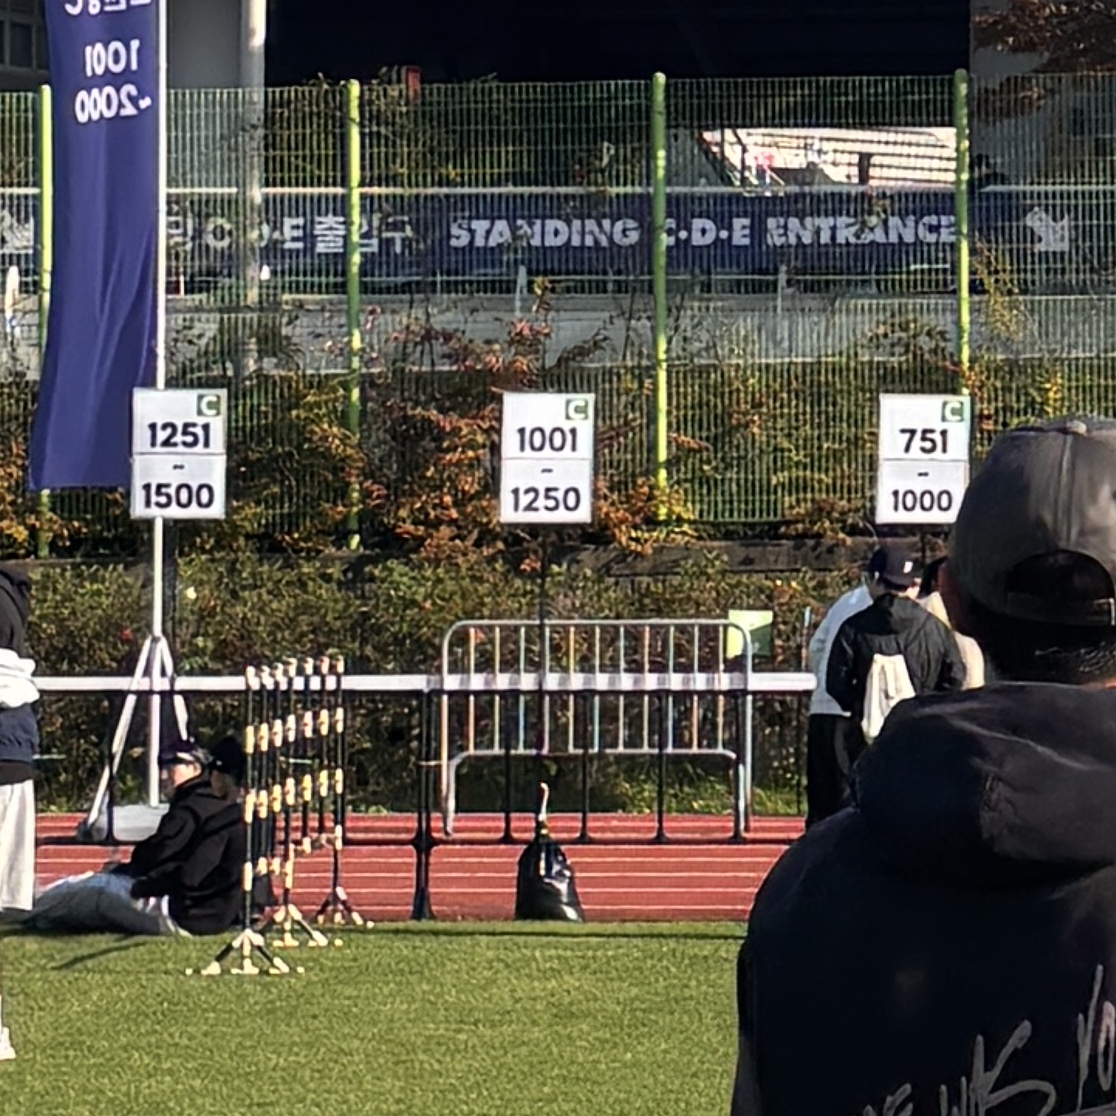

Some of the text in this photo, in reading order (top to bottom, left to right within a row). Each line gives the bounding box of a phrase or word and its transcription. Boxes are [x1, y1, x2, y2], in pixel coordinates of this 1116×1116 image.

[450, 218, 639, 247] STANDING
[766, 214, 957, 245] ENTRANCE
[200, 395, 219, 416] C
[567, 399, 588, 420] C
[943, 401, 964, 421] C
[147, 421, 211, 449] 1251
[517, 426, 577, 453] 1001
[899, 428, 948, 454] 751
[142, 482, 214, 509] 1500
[511, 486, 581, 513] 1250
[892, 489, 953, 513] 1000
